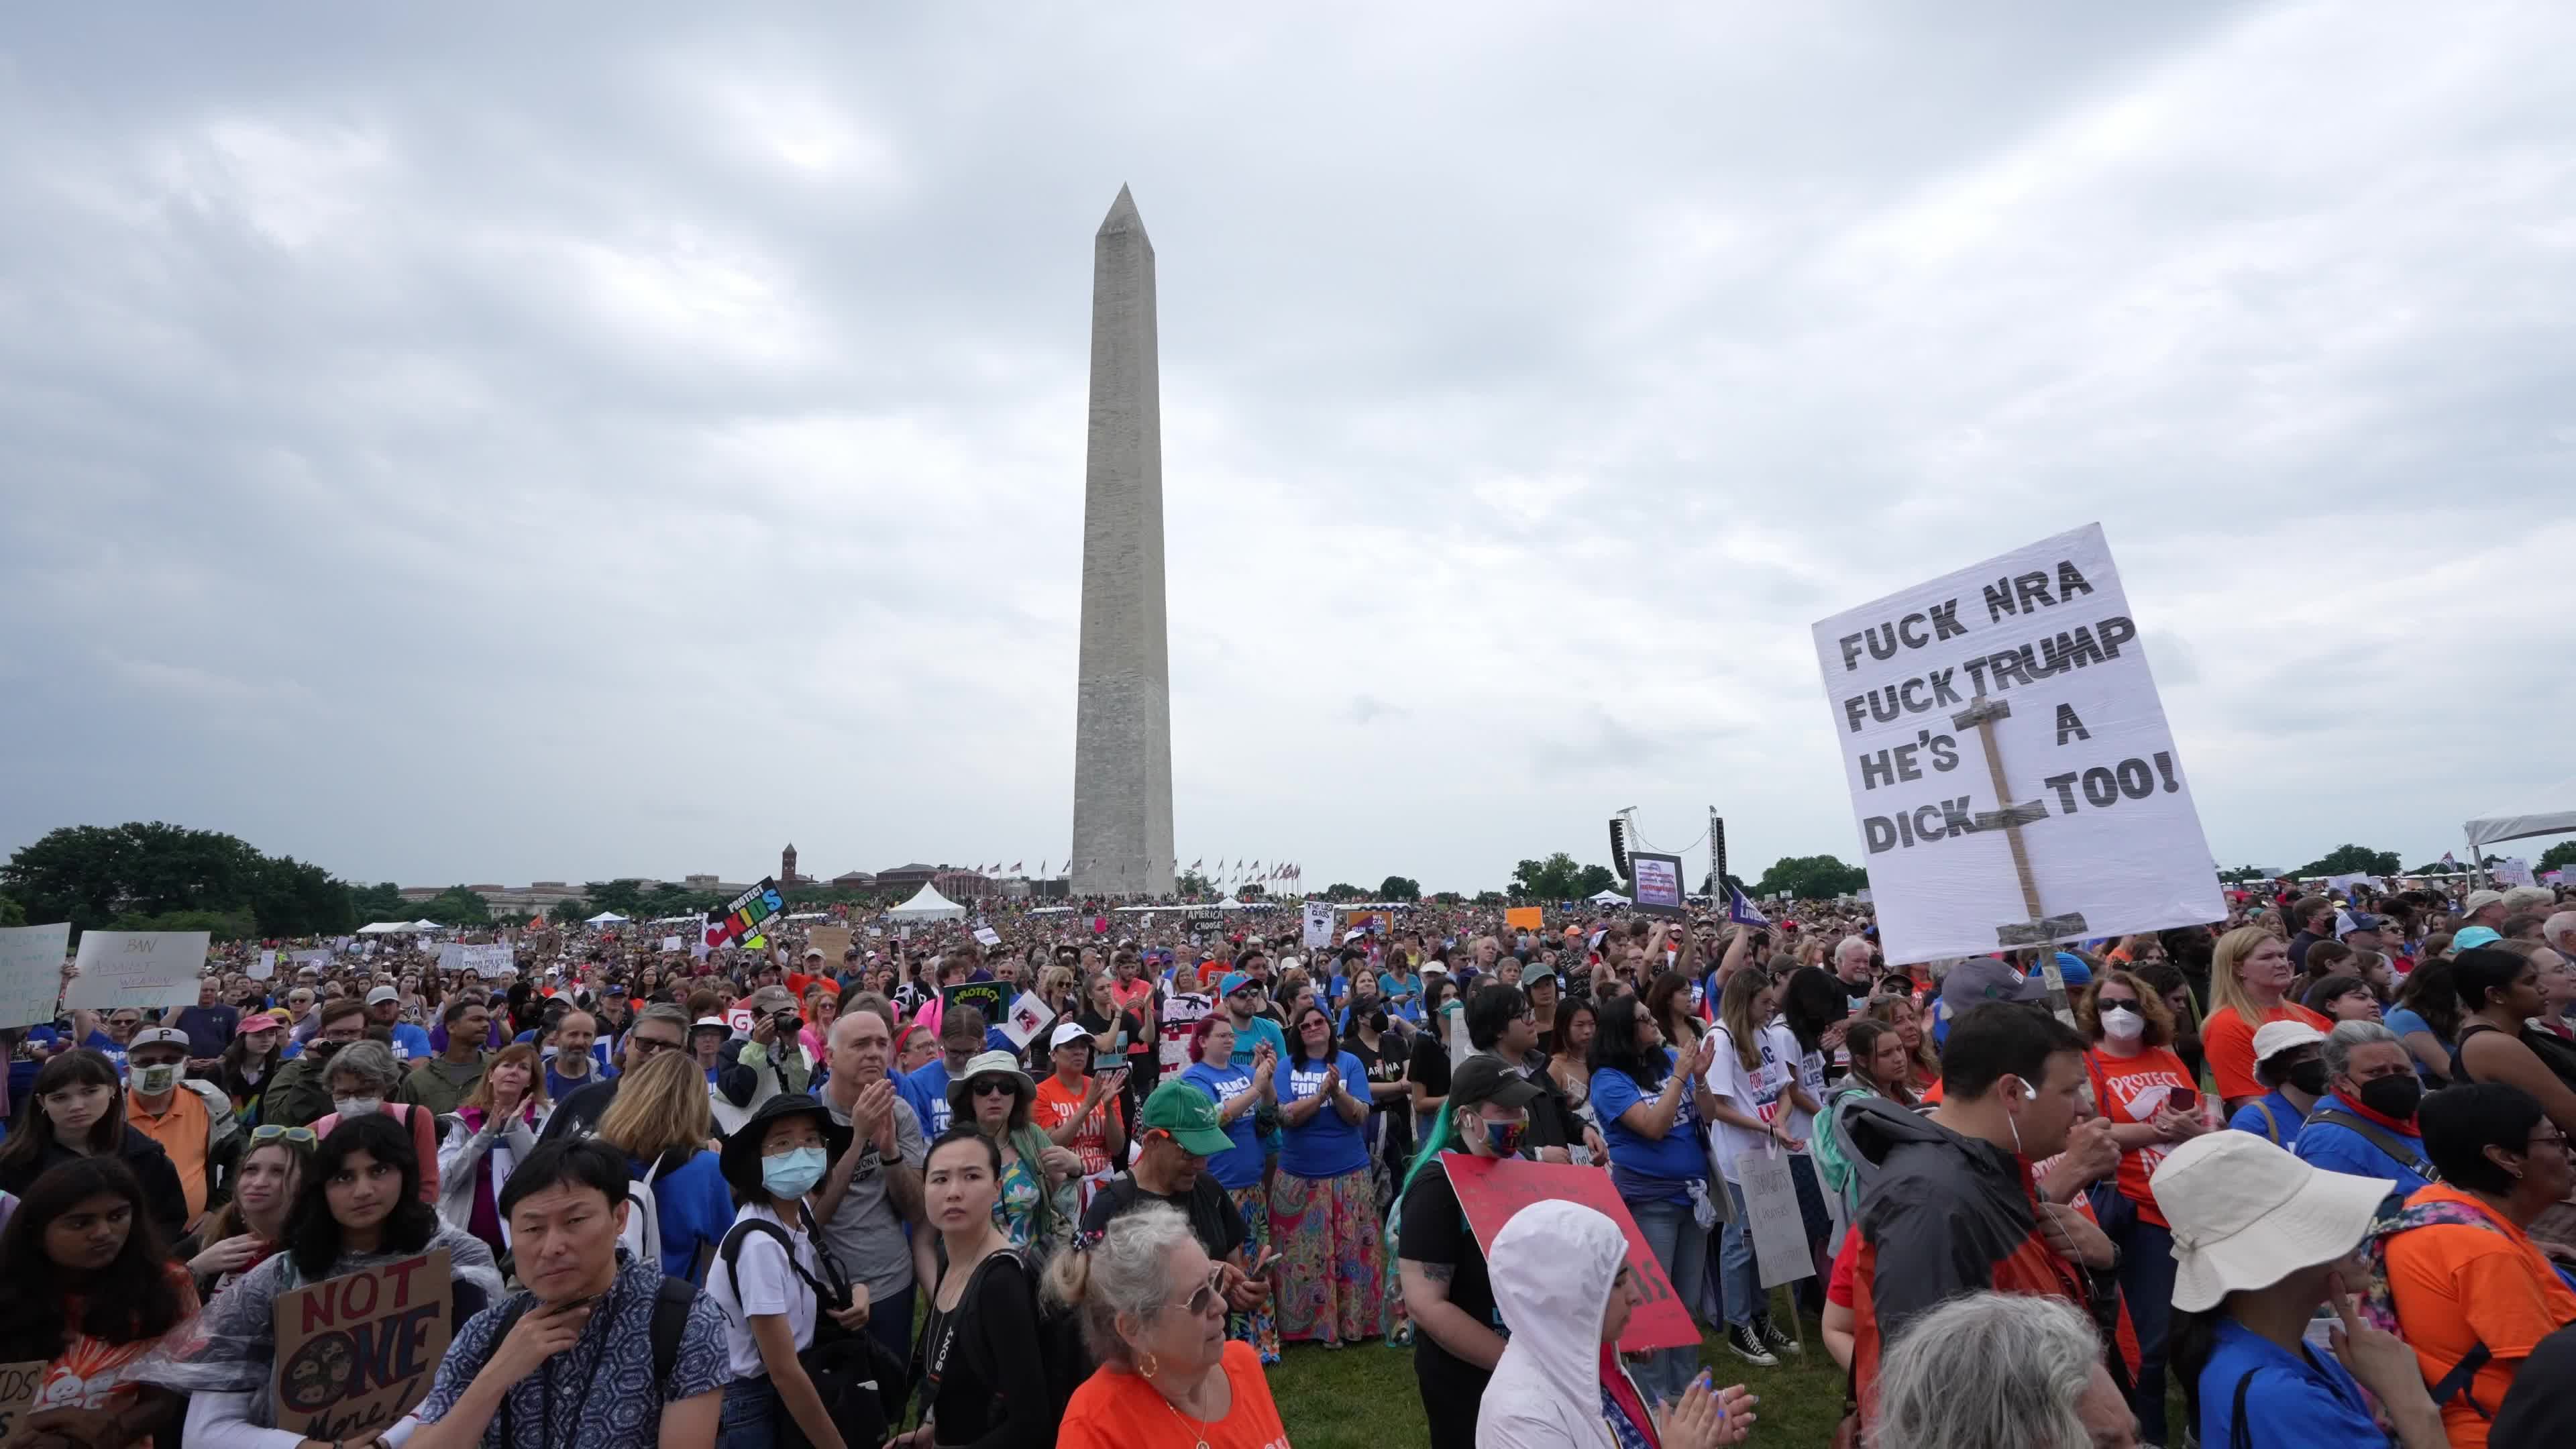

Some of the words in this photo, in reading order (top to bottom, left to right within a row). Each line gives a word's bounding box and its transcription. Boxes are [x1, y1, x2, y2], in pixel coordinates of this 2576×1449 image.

[1839, 598, 1968, 671] FUCK
[1982, 559, 2094, 623] NRA
[1844, 667, 1963, 733] FUCK
[1964, 616, 2136, 698] TRUMP
[1860, 730, 1960, 790] HE'S
[2055, 703, 2092, 746] A
[1863, 795, 1978, 855] DICK
[2044, 751, 2180, 815] TOO!
[725, 889, 783, 938] KIDS
[728, 883, 763, 913] PROTECT
[1187, 910, 1224, 920] AMERICA
[742, 926, 759, 941] NOT
[1195, 921, 1224, 930] CHOOSE!
[464, 959, 483, 967] THAN
[953, 987, 1000, 1005] PROTECT
[1750, 1072, 1764, 1090] FOR
[2106, 1071, 2185, 1104] PROTECT
[302, 1255, 427, 1335] NOT
[280, 1300, 440, 1414] ONE
[935, 1326, 954, 1373] SONY
[304, 1377, 421, 1442] More!
